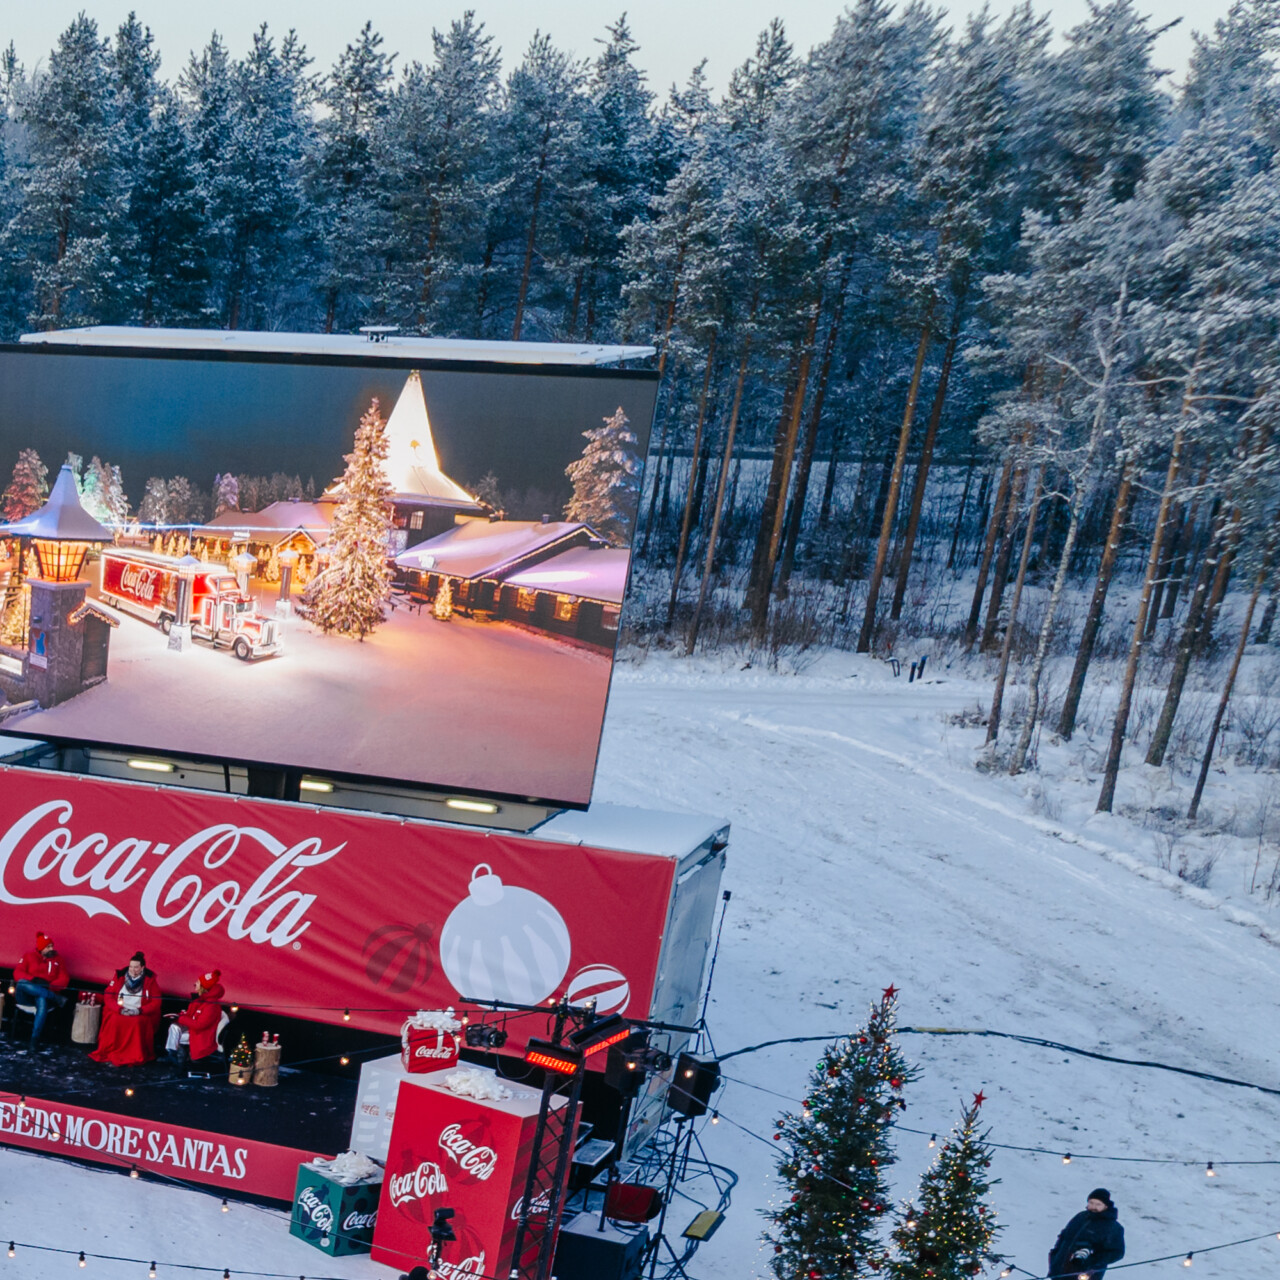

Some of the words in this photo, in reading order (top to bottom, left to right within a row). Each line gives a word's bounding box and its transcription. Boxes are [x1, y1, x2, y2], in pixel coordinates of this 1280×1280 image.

[120, 562, 157, 600] Coca-Cola
[63, 1114, 144, 1159] MORE
[145, 1130, 249, 1180] SANTAS
[389, 1161, 449, 1208] Coca-Cola
